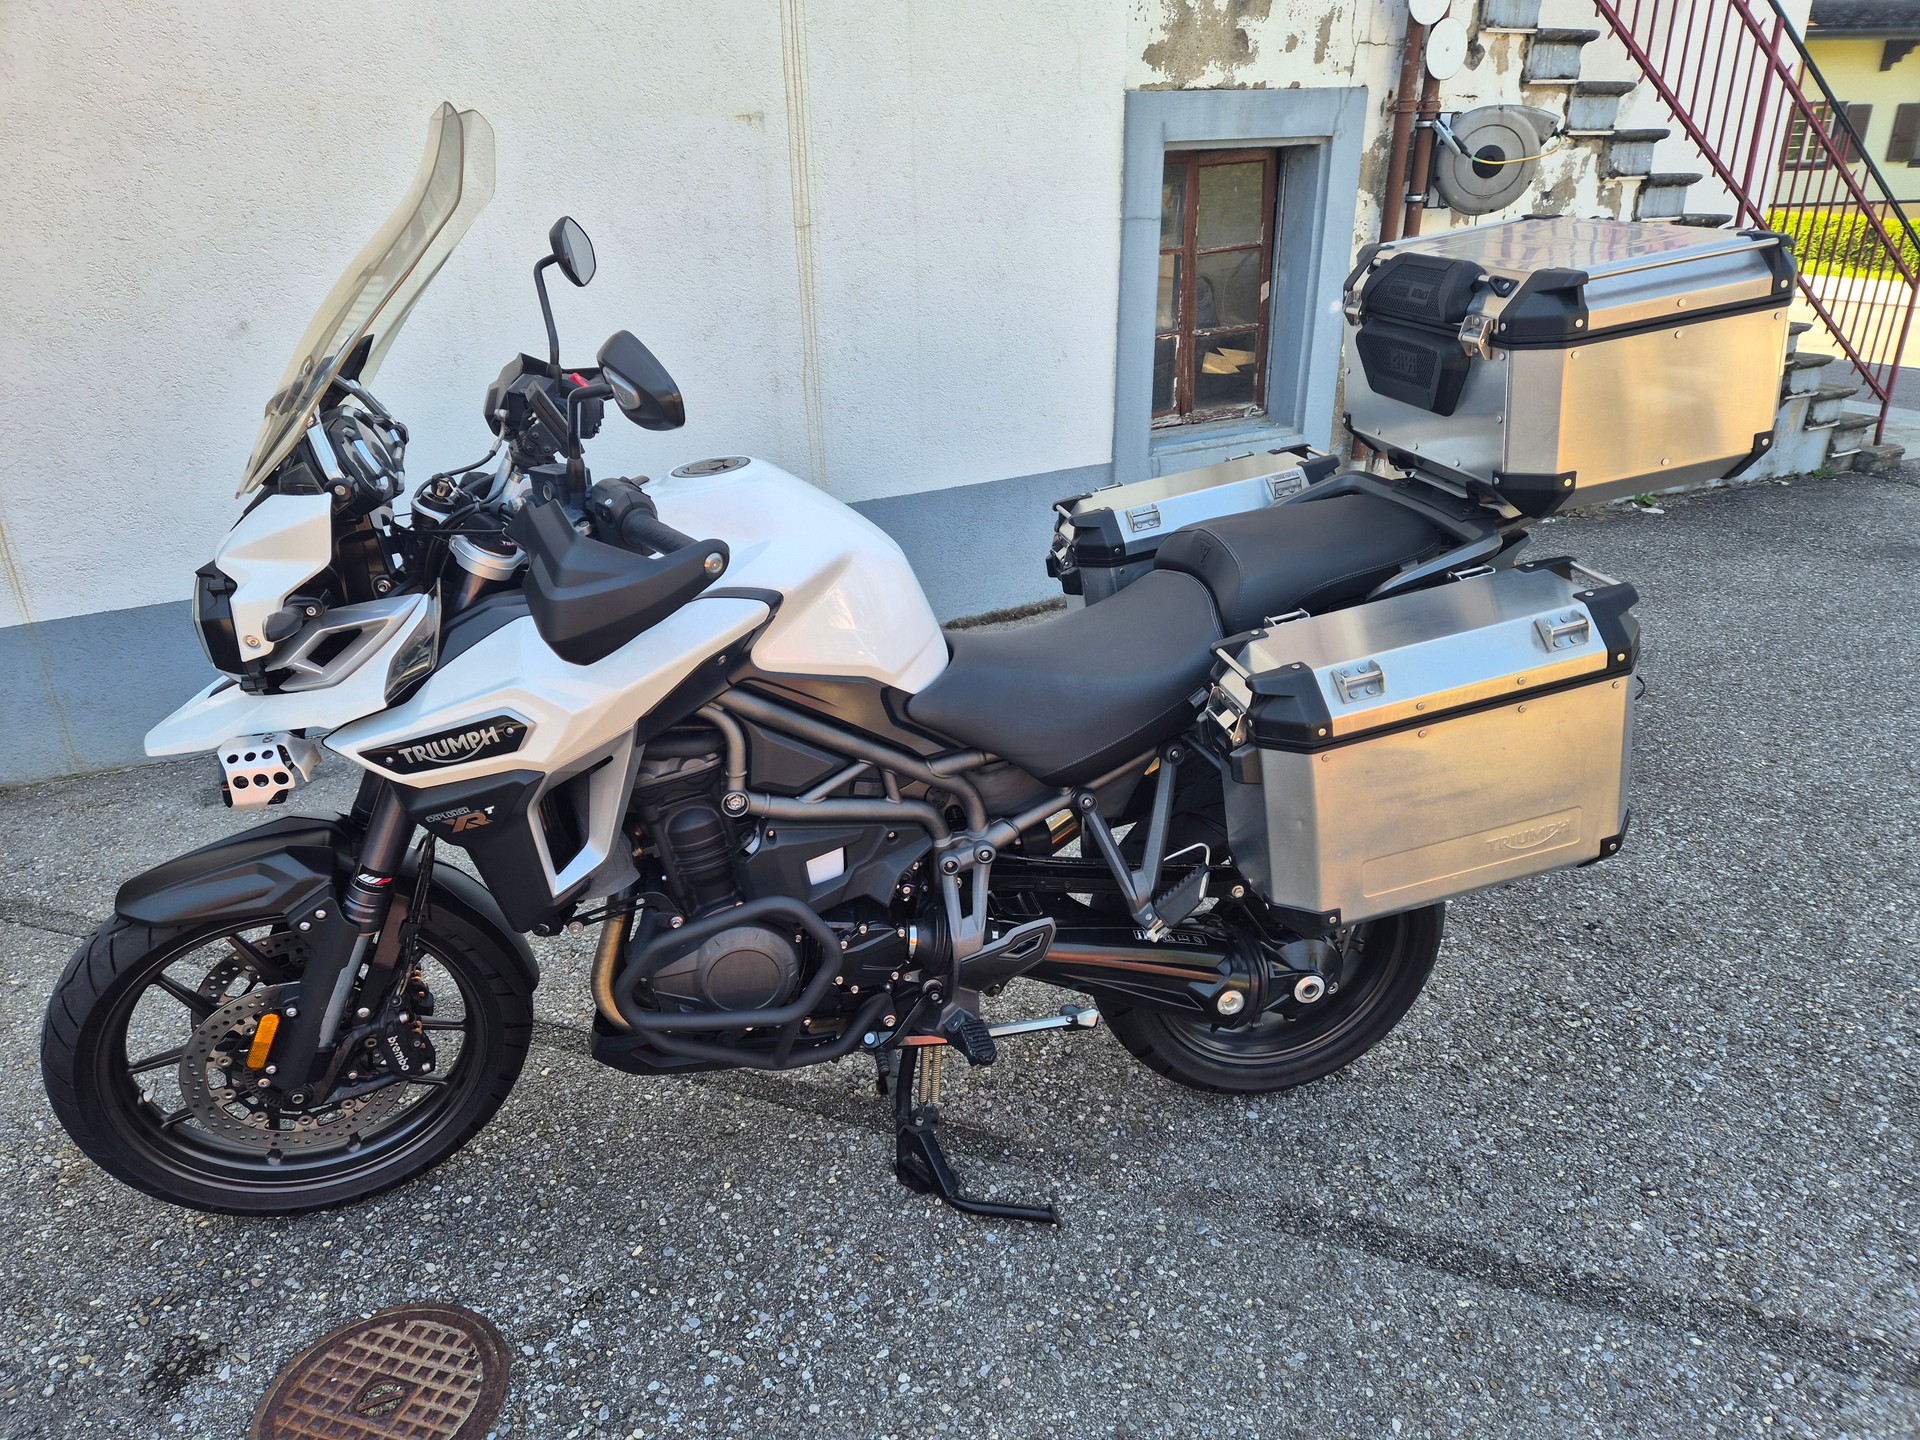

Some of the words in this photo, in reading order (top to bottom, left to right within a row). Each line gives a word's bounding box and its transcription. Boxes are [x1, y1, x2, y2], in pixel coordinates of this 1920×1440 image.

[398, 726, 500, 764] TRIUMPH
[425, 806, 471, 823] EXPLORER
[1486, 818, 1571, 852] TRIUMPH
[387, 1035, 409, 1071] brembo
